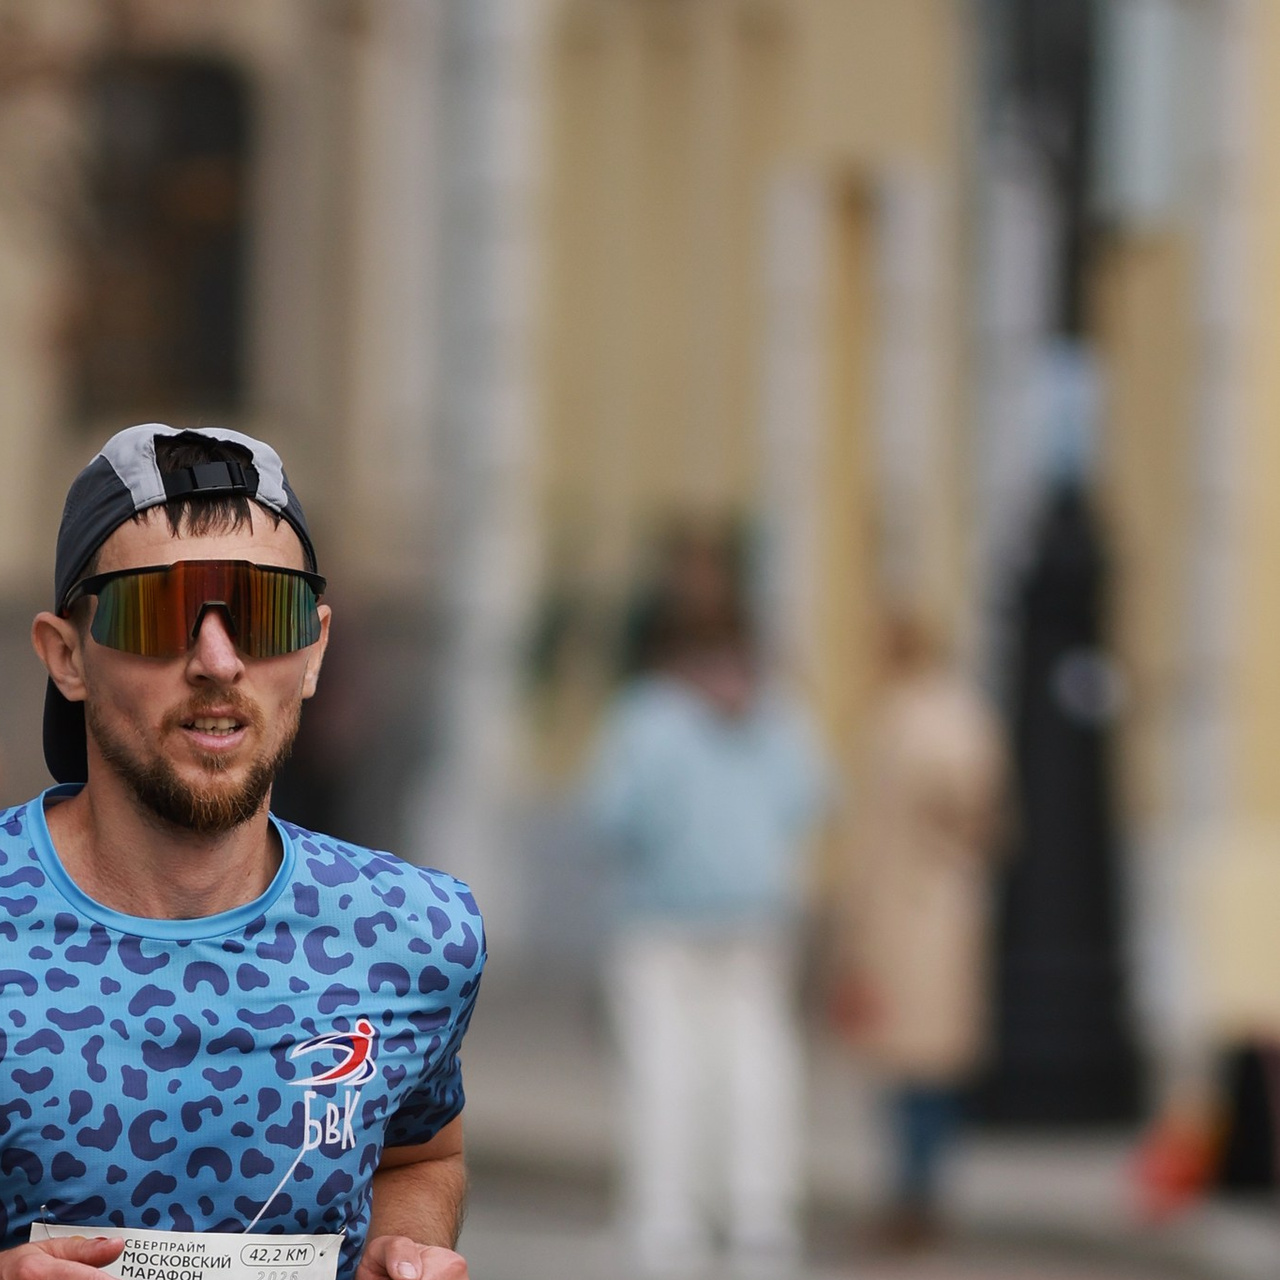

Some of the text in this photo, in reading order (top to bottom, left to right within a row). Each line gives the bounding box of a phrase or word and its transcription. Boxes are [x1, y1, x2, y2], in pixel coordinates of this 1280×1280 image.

[124, 1238, 206, 1253] СБЕРПРАЙМ
[123, 1251, 232, 1269] МОСКОВСКИЙ
[249, 1248, 281, 1263] 42,2
